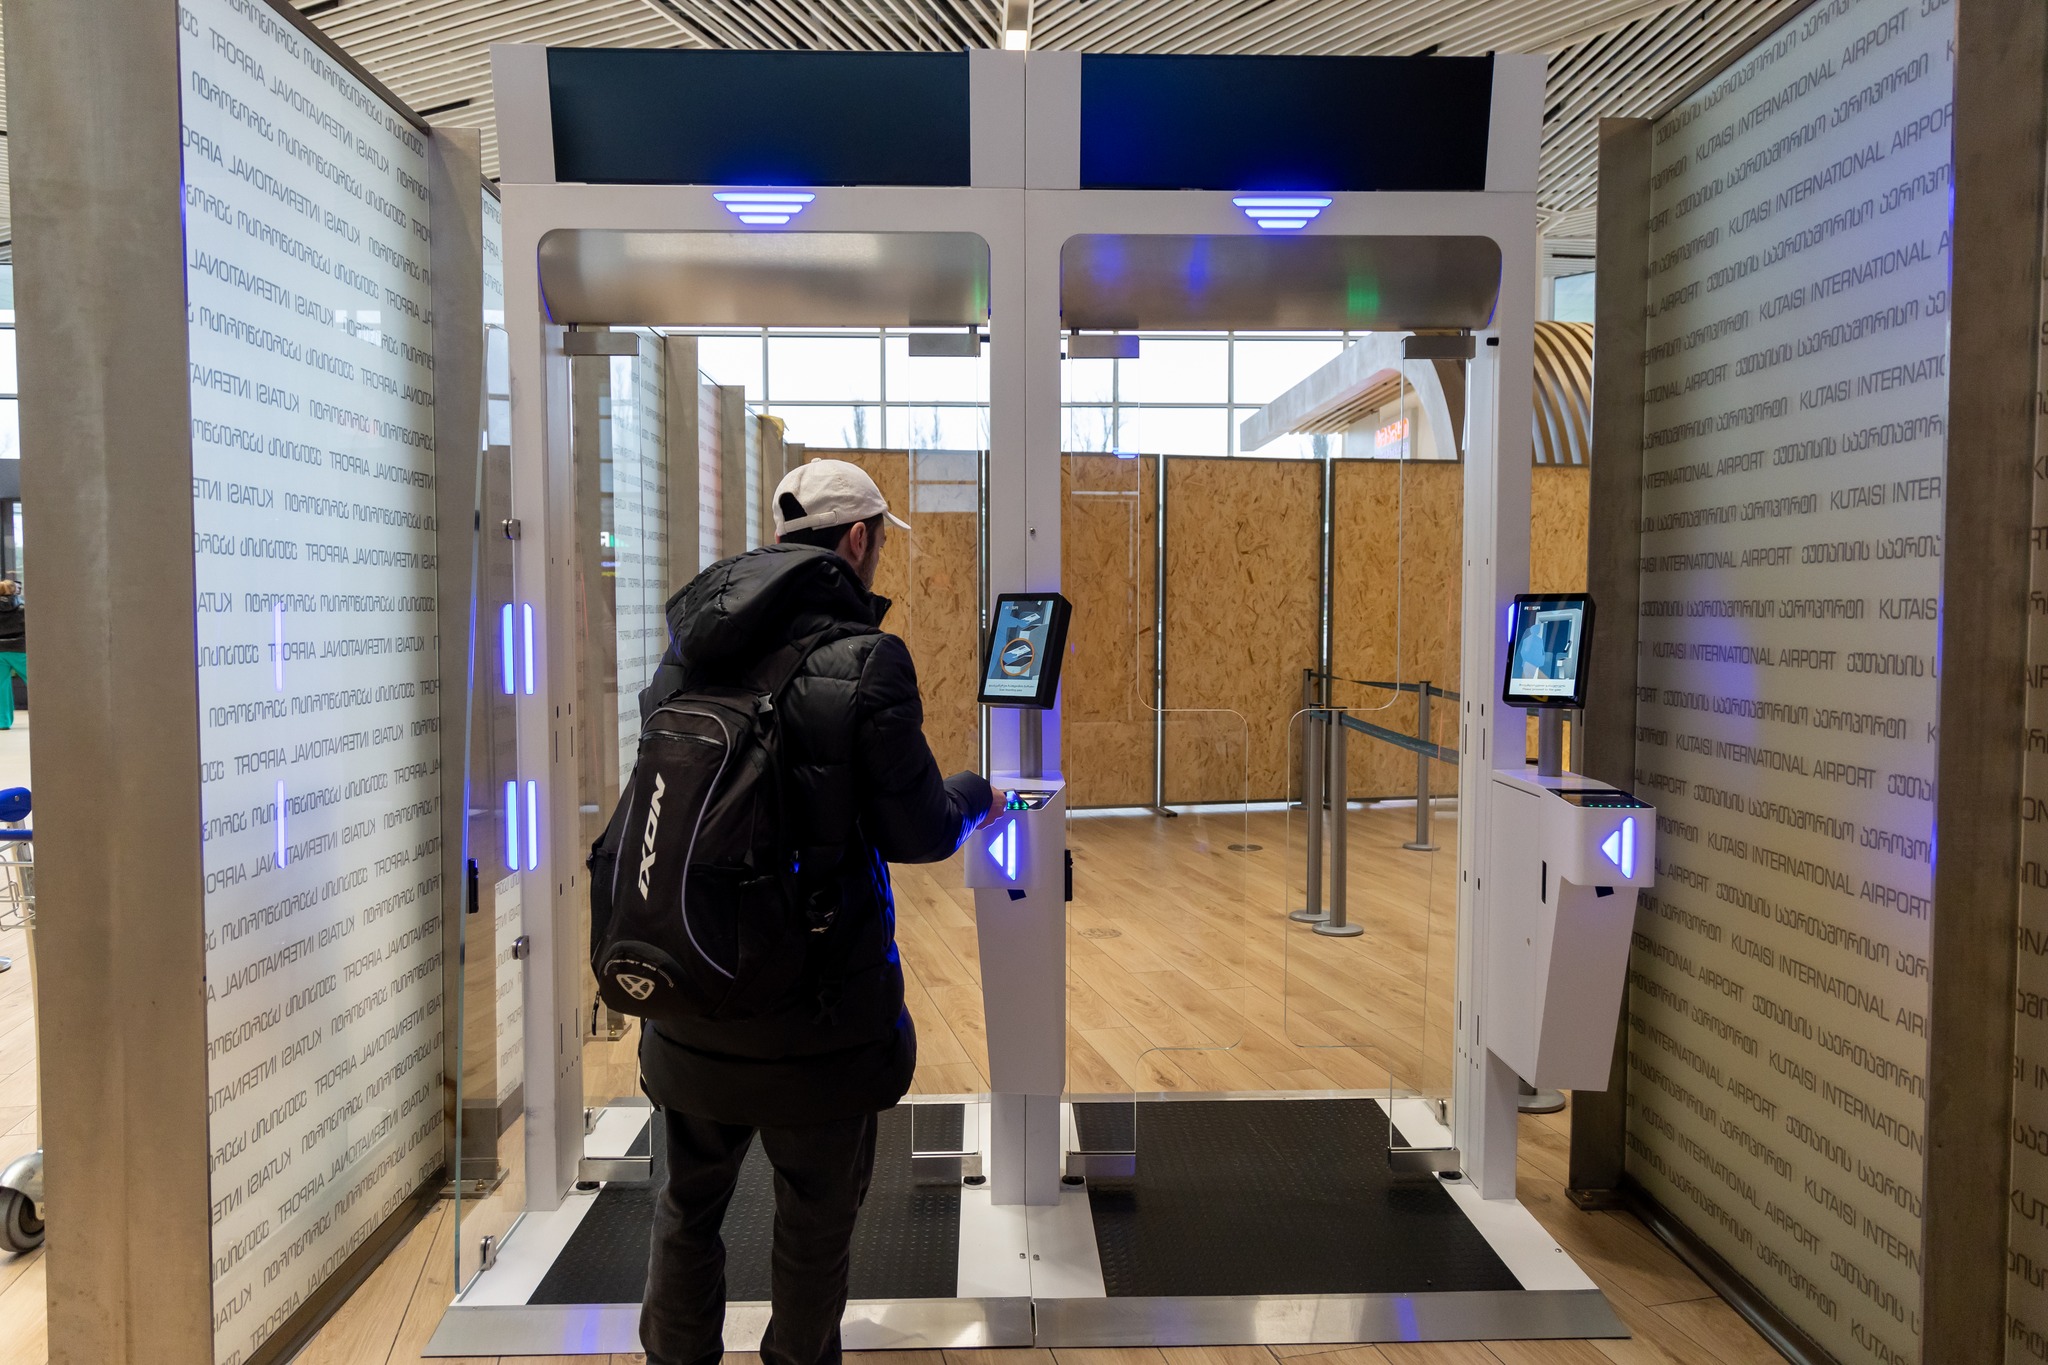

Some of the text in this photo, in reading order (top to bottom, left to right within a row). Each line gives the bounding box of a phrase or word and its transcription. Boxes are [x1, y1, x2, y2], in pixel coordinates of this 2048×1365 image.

[1695, 6, 1908, 164] KUTAISI INTERNATIONAL AIRPORT
[1675, 51, 1929, 220] ქუთაისის საერთაშორისო აეროპორტი
[1728, 198, 1771, 237] KUTAISI
[1775, 137, 1885, 213] INTERNATIONAL
[1706, 252, 1759, 294] ქუთაისის
[1763, 197, 1873, 268] საერთაშორისო
[1759, 236, 1931, 322] KUTAISI INTERNATIONAL
[1683, 309, 1748, 351] აეროპორტი
[1735, 298, 1919, 378] ქუთაისის საერთაშორისო
[1684, 363, 1727, 393] AIRPORT
[1799, 379, 1851, 411] KUTAISI
[1716, 396, 1787, 432] აეროპორტი
[1716, 450, 1764, 476] AIRPORT
[1773, 435, 1837, 466] ქუთაისის
[1740, 493, 1817, 521] აეროპორტი
[1830, 484, 1885, 510] KUTAISI
[1740, 546, 1792, 567] AIRPORT
[1801, 540, 1870, 564] ქუთაისის
[1686, 599, 1774, 617] საერთაშორისო
[1778, 598, 1864, 619] აეროპორტი
[1689, 643, 1774, 666] INTERNATIONAL
[1778, 648, 1836, 670] AIRPORT
[1846, 651, 1924, 677] ქუთაისის
[1663, 689, 1906, 740] ქუთაისის საერთაშორისო აეროპორტი
[1676, 733, 1876, 790] KUTAISI INTERNATIONAL AIRPORT
[638, 772, 665, 900] IXON
[1693, 783, 1854, 843] ქუთაისის საერთაშორისო
[1667, 862, 1709, 894] AIRPORT
[1707, 831, 1929, 922] KUTAISI INTERNATIONAL AIRPORT
[1661, 900, 1721, 944] აეროპორტი
[1716, 880, 1889, 967] ქუთაისის საერთაშორისო
[1698, 965, 1744, 1004] AIRPORT
[1731, 932, 1889, 1022] KUTAISI INTERNATIONAL
[1691, 1003, 1758, 1059] აეროპორტი
[1752, 991, 1812, 1042] ქუთაისის
[1769, 1049, 1816, 1094] KUTAISI
[1727, 1075, 1776, 1124] AIRPORT
[1719, 1114, 1792, 1183] აეროპორტი
[1786, 1112, 1852, 1174] ქუთაისის
[1678, 1130, 1760, 1211] INTERNATIONAL
[1764, 1197, 1820, 1258] AIRPORT
[1804, 1175, 1856, 1229] KUTAISI
[1668, 1164, 1837, 1323] საერთაშორისო აეროპორტი
[1830, 1248, 1904, 1325] ქუთაისის
